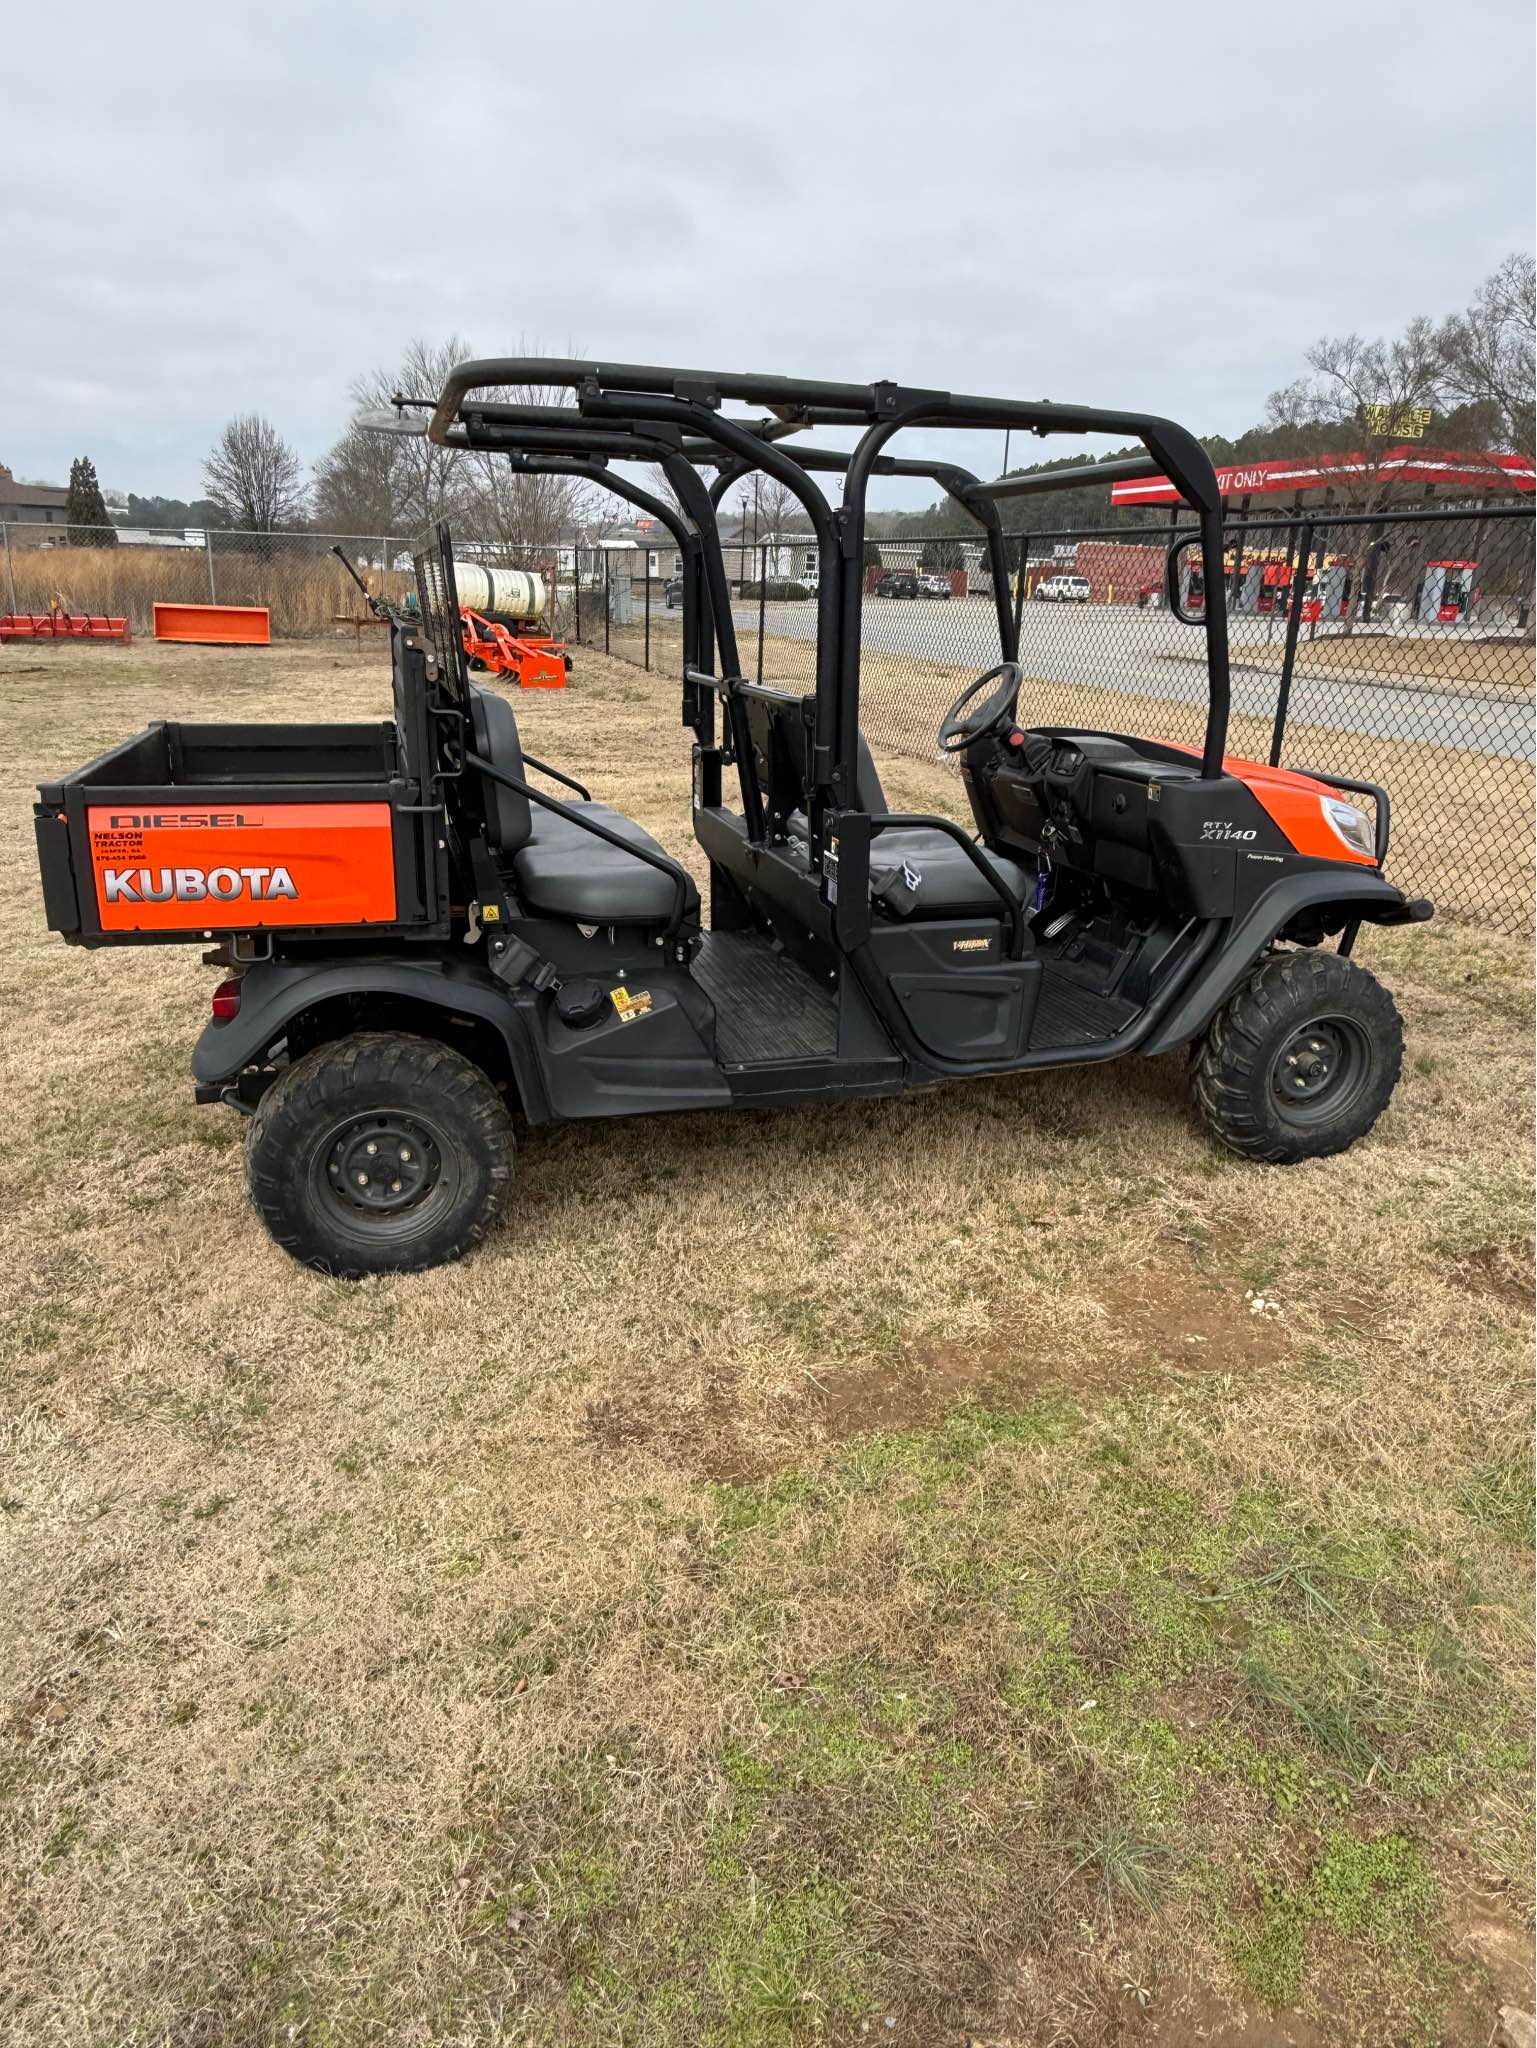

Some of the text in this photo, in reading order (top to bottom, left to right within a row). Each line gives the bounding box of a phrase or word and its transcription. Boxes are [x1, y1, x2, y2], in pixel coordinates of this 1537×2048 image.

[1364, 405, 1432, 424] WALE
[1234, 469, 1268, 488] ONLY
[110, 814, 263, 829] DIESEL
[1203, 821, 1233, 829] RTV
[94, 831, 143, 840] NELSON
[1200, 829, 1257, 840] X1140
[94, 840, 143, 848] TRACTOR
[103, 866, 299, 902] KUBOTA
